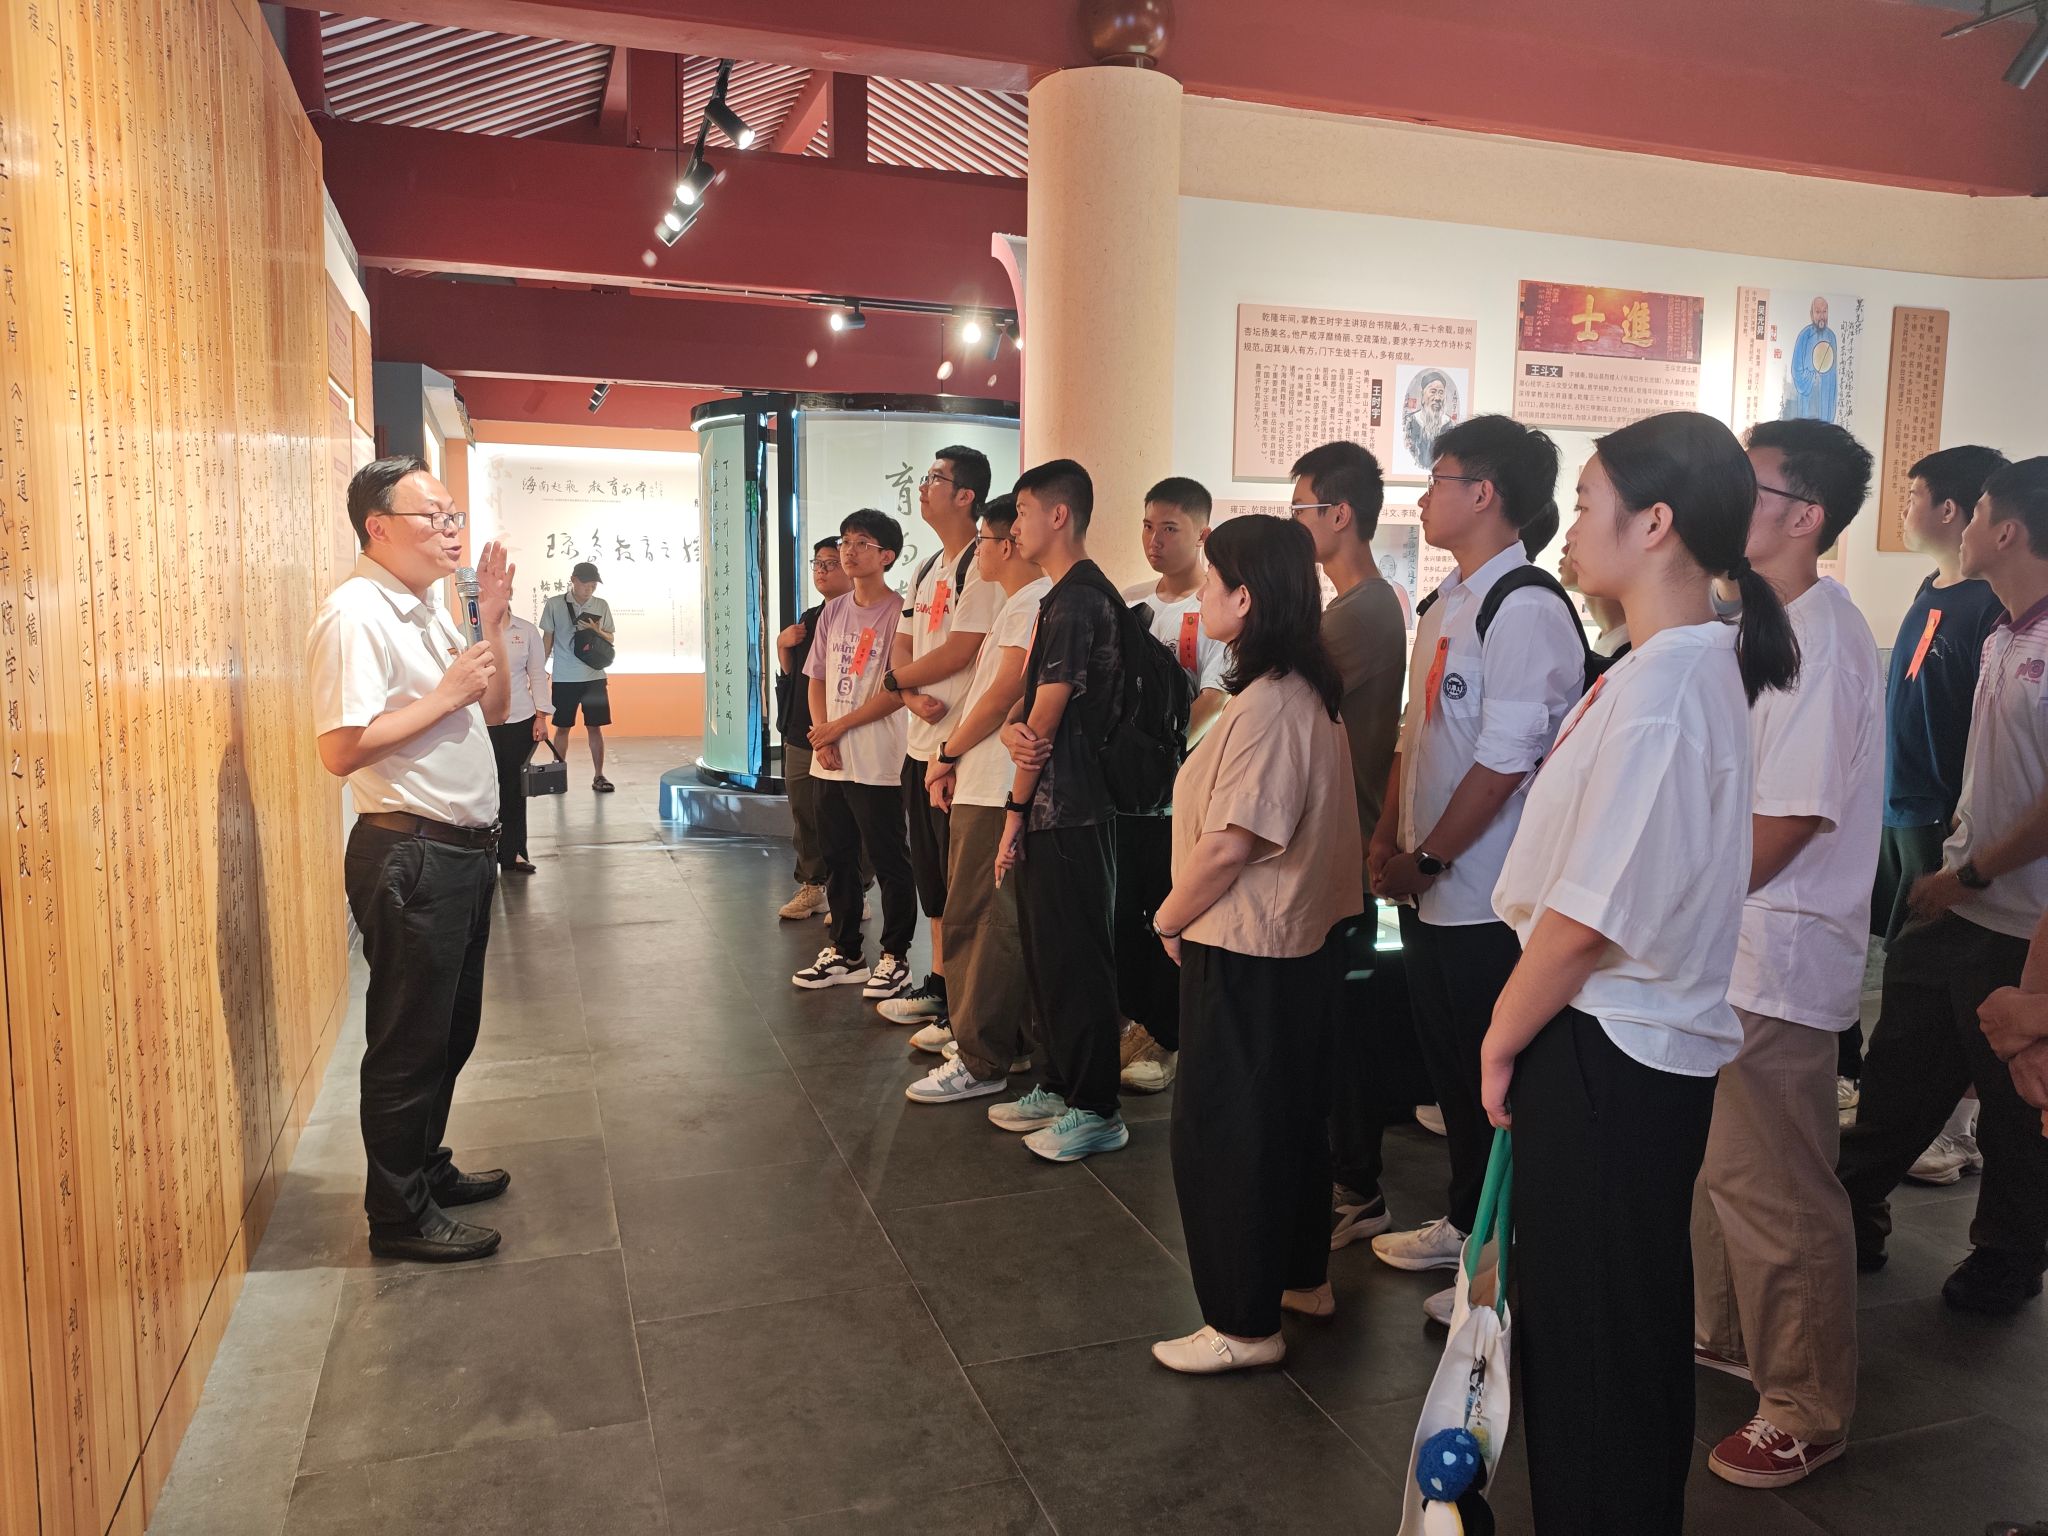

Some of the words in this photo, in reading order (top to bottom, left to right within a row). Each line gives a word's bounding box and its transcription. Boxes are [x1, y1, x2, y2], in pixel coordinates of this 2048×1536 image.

[1531, 365, 1558, 377] 王斗文
[1372, 386, 1381, 420] 王时宇
